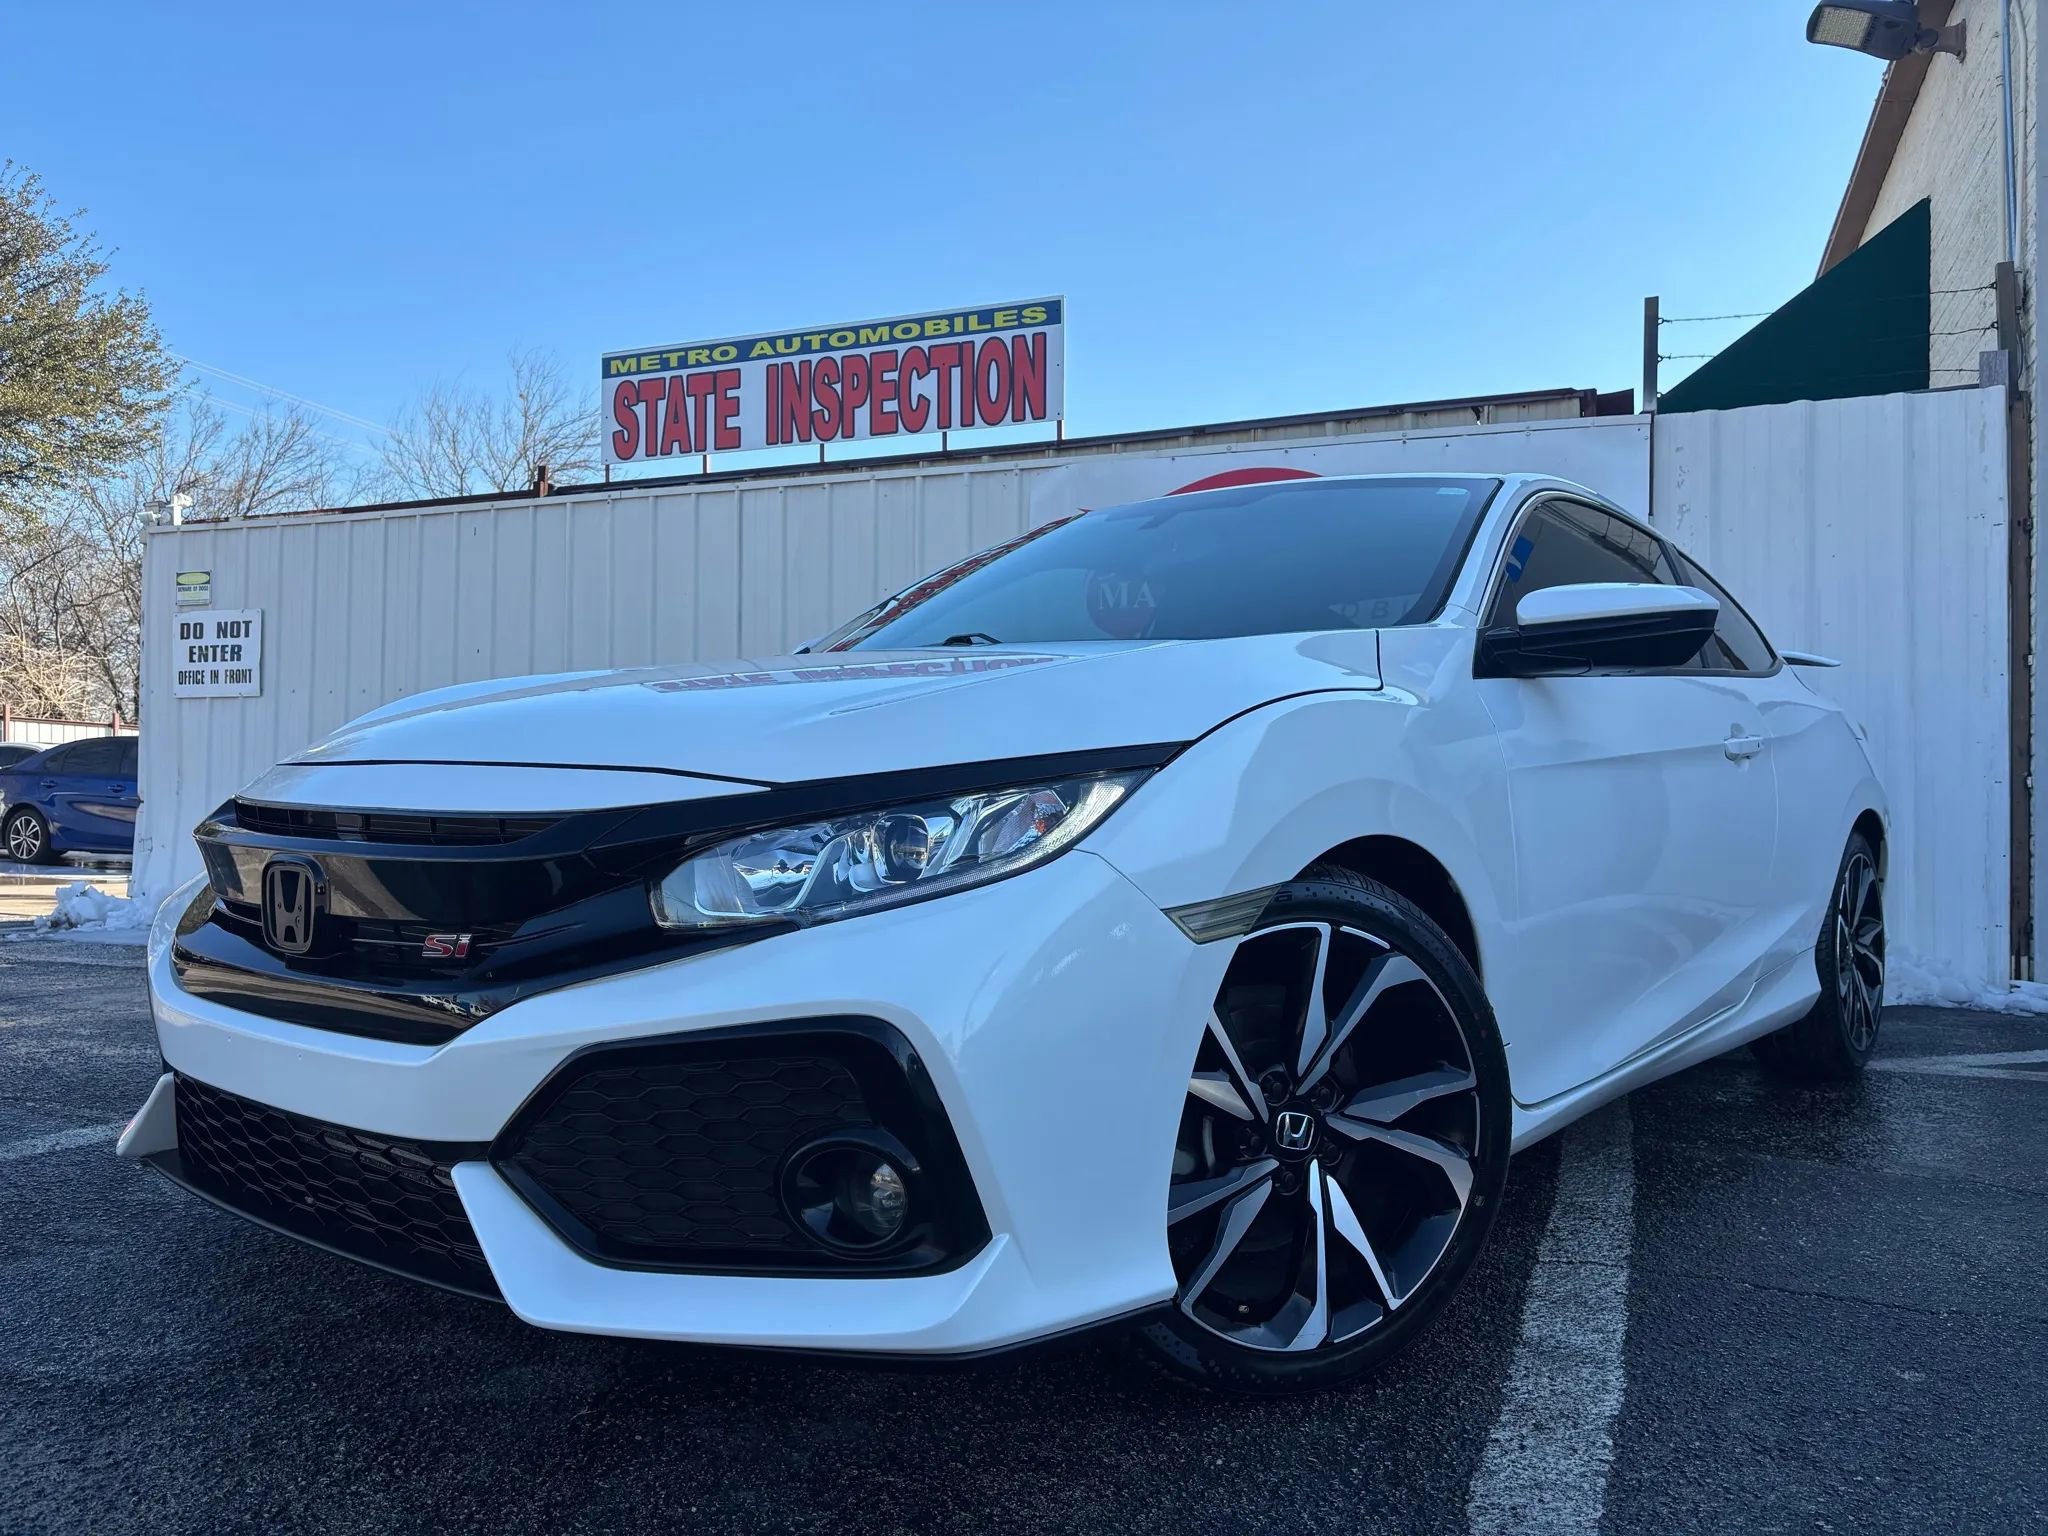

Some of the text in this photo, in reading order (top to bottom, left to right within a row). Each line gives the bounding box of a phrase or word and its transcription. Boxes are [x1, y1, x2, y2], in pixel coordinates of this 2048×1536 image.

[610, 305, 1048, 375] METRO AUTOMOBILES
[612, 332, 1048, 460] STATE INSPECTION
[180, 620, 252, 640] DO NOT
[188, 644, 242, 663] ENTER
[178, 668, 252, 685] OFFICE IN FRONT
